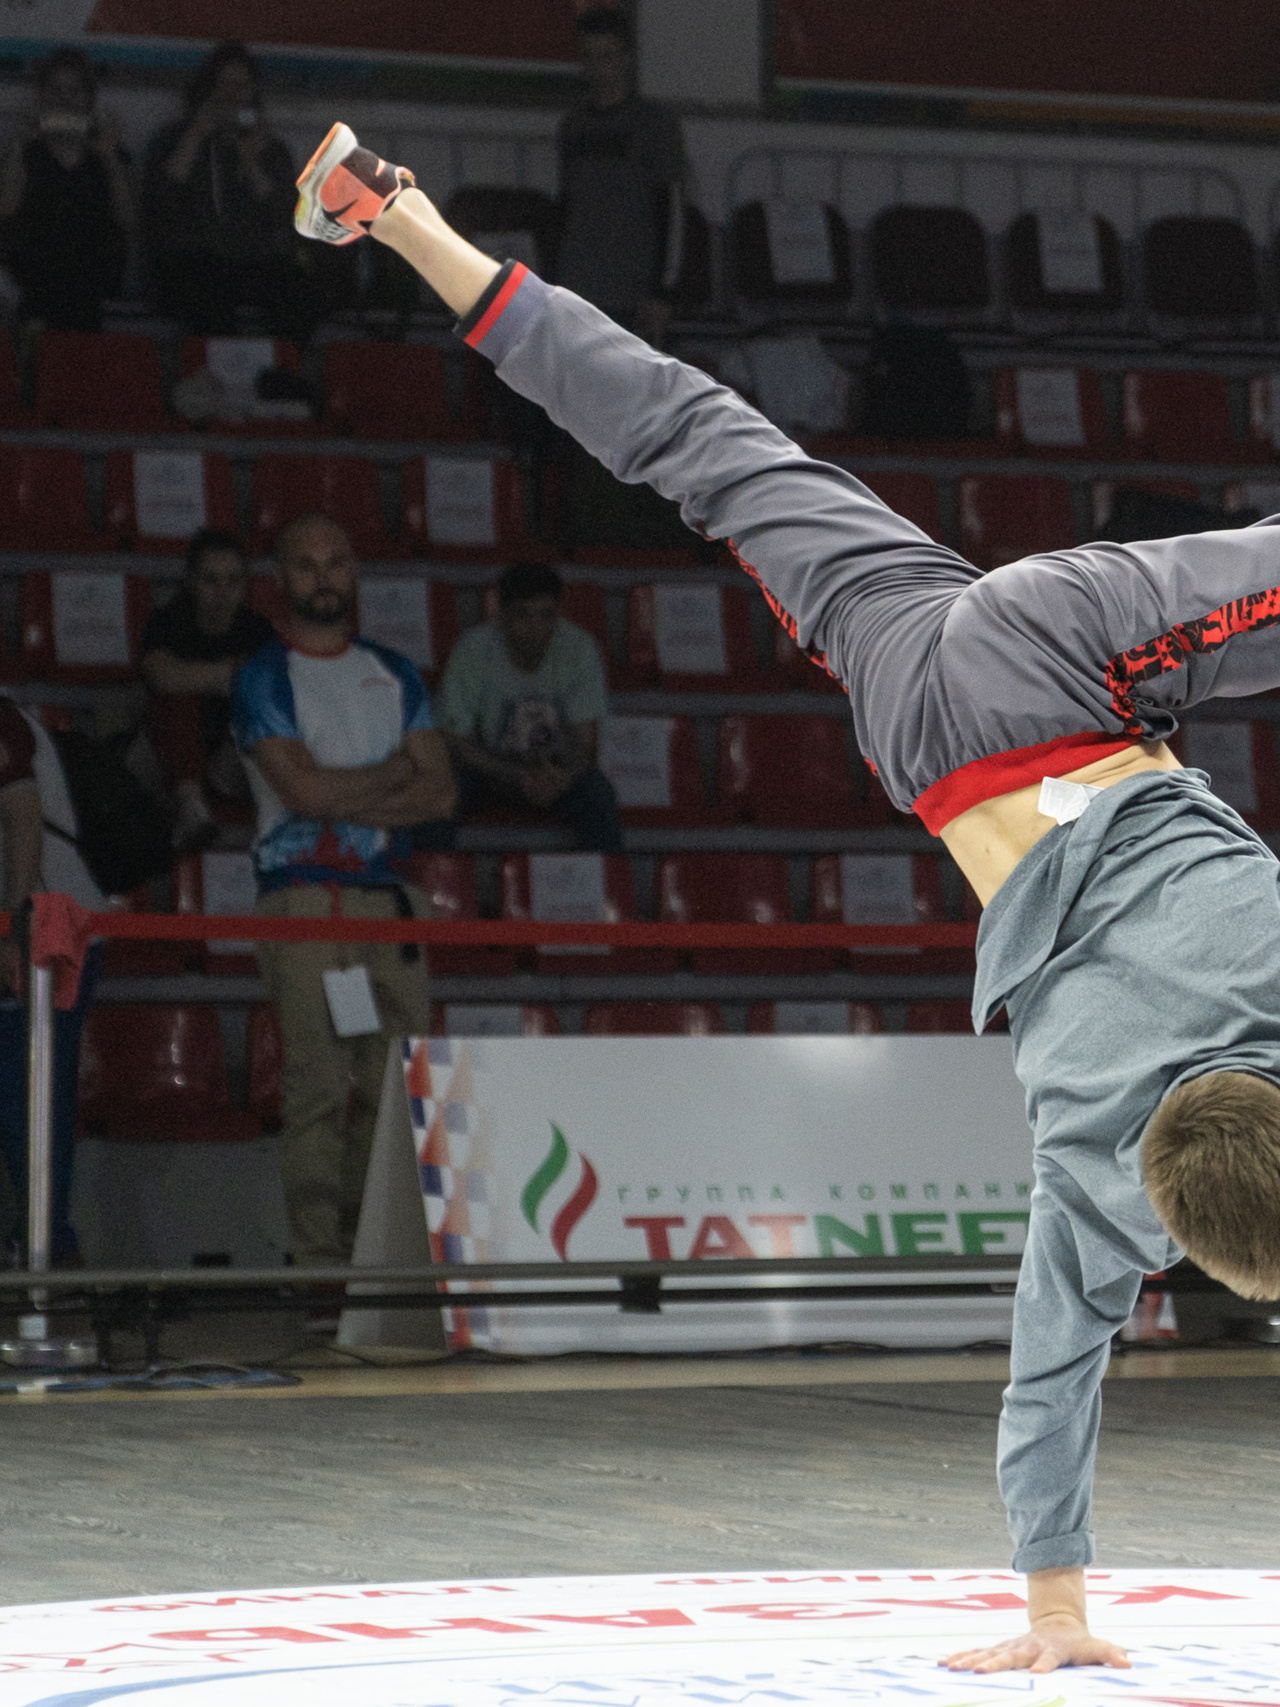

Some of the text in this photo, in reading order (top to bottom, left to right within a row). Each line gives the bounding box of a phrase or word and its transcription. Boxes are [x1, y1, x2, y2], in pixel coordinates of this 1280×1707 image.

[616, 1184, 784, 1202] ГРУППА
[624, 1212, 1032, 1260] TATNEF
[91, 1585, 518, 1612] ФИНАЛ
[149, 1585, 1252, 1642] КАЗАНЬ
